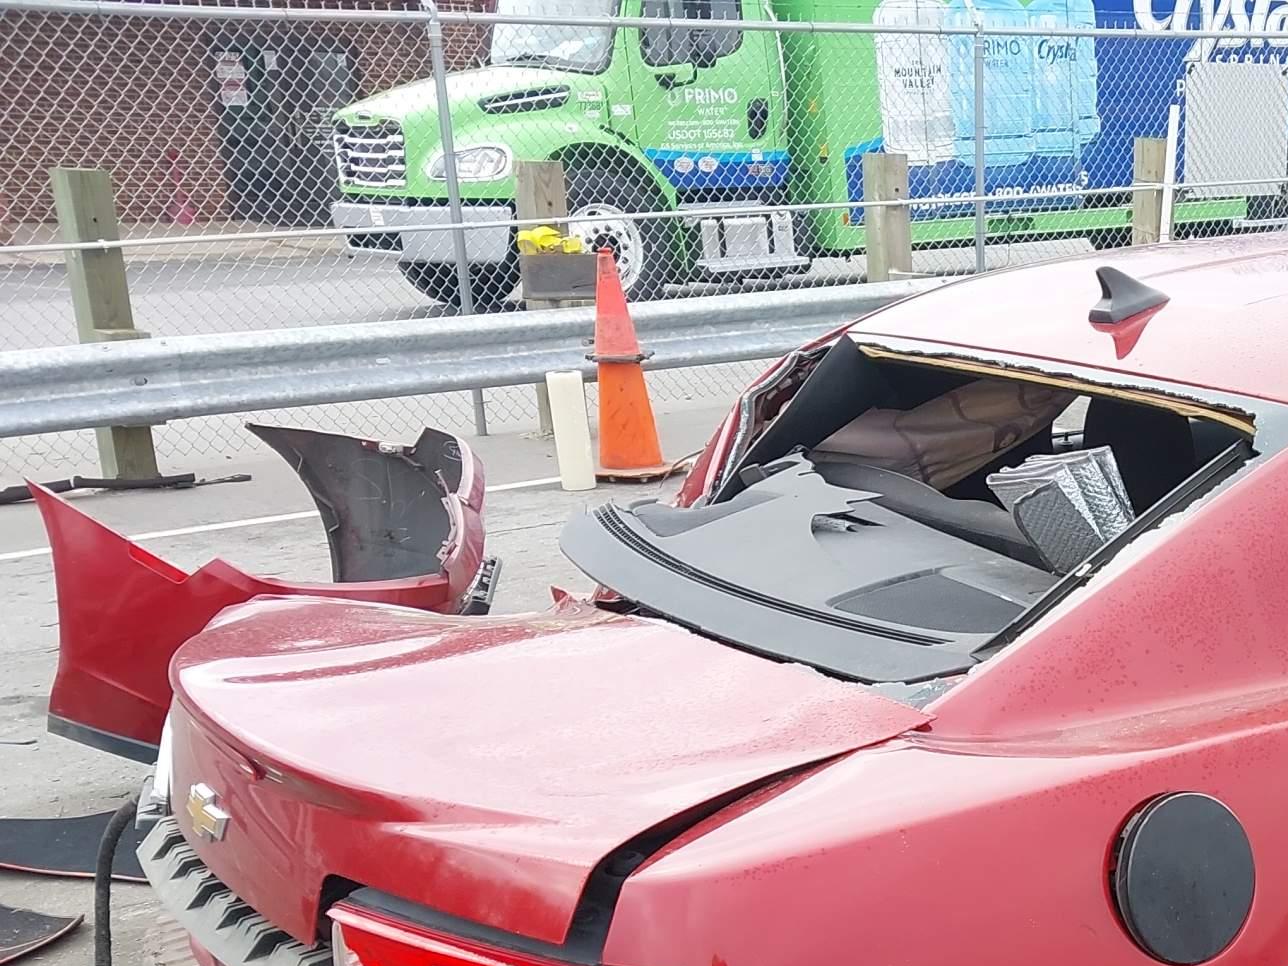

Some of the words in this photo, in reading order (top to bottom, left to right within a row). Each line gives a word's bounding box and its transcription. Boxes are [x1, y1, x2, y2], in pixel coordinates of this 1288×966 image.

[983, 40, 1021, 56] RIMO
[894, 64, 942, 78] MOUNTAIN
[902, 75, 935, 88] VALLEY
[685, 87, 738, 104] PRIMO
